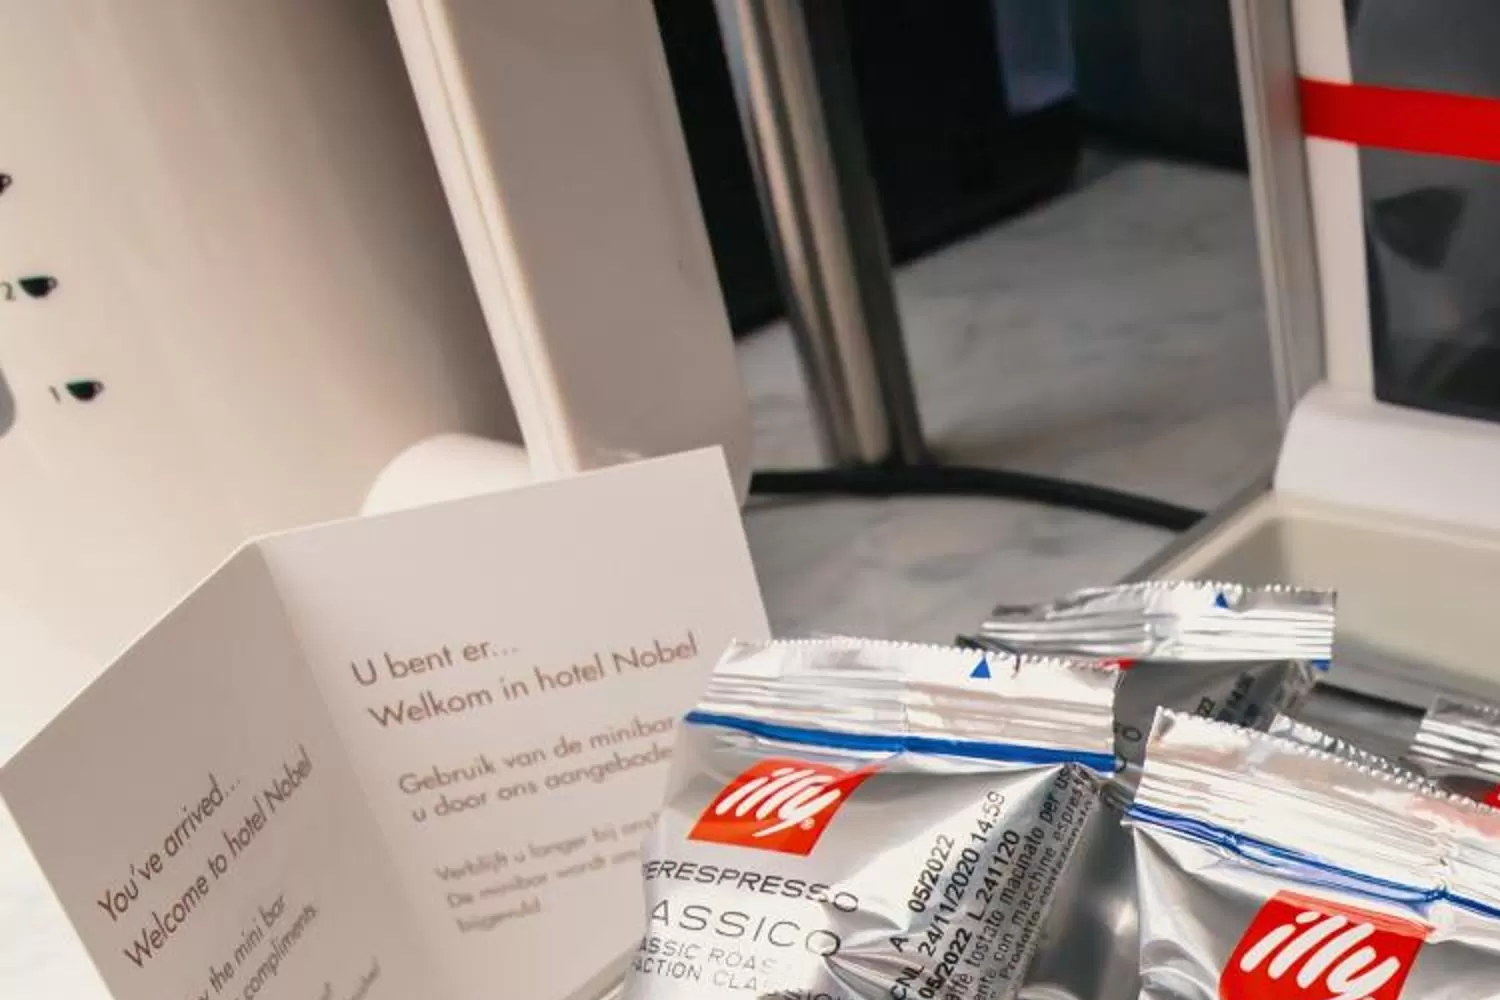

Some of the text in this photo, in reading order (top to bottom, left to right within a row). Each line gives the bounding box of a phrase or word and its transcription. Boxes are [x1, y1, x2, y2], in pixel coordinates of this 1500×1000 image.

[351, 659, 378, 687] U
[384, 644, 453, 680] bent
[367, 630, 700, 729] Welkom in hotel Nobel
[399, 716, 676, 795] Gebruik van de minibar
[412, 806, 428, 823] u
[434, 784, 491, 817] door
[497, 780, 539, 801] ons
[714, 766, 842, 838] illy
[97, 852, 164, 923] You've
[124, 743, 313, 969] Welcome to hotel Nobel
[643, 860, 859, 914] ERESPRESSO
[889, 833, 956, 952] A 05/2022
[964, 910, 1005, 969] tostato
[1000, 826, 1046, 906] macinato
[1038, 793, 1062, 826] per
[651, 899, 842, 957] ASSICO
[917, 846, 981, 957] 24/11/2020
[993, 932, 1014, 963] con
[1010, 846, 1057, 926] macchine
[209, 961, 234, 993] the
[234, 920, 265, 967] mini
[258, 895, 286, 929] bar
[639, 936, 779, 973] ASSIC ROAS
[917, 926, 974, 1000] 05/2022
